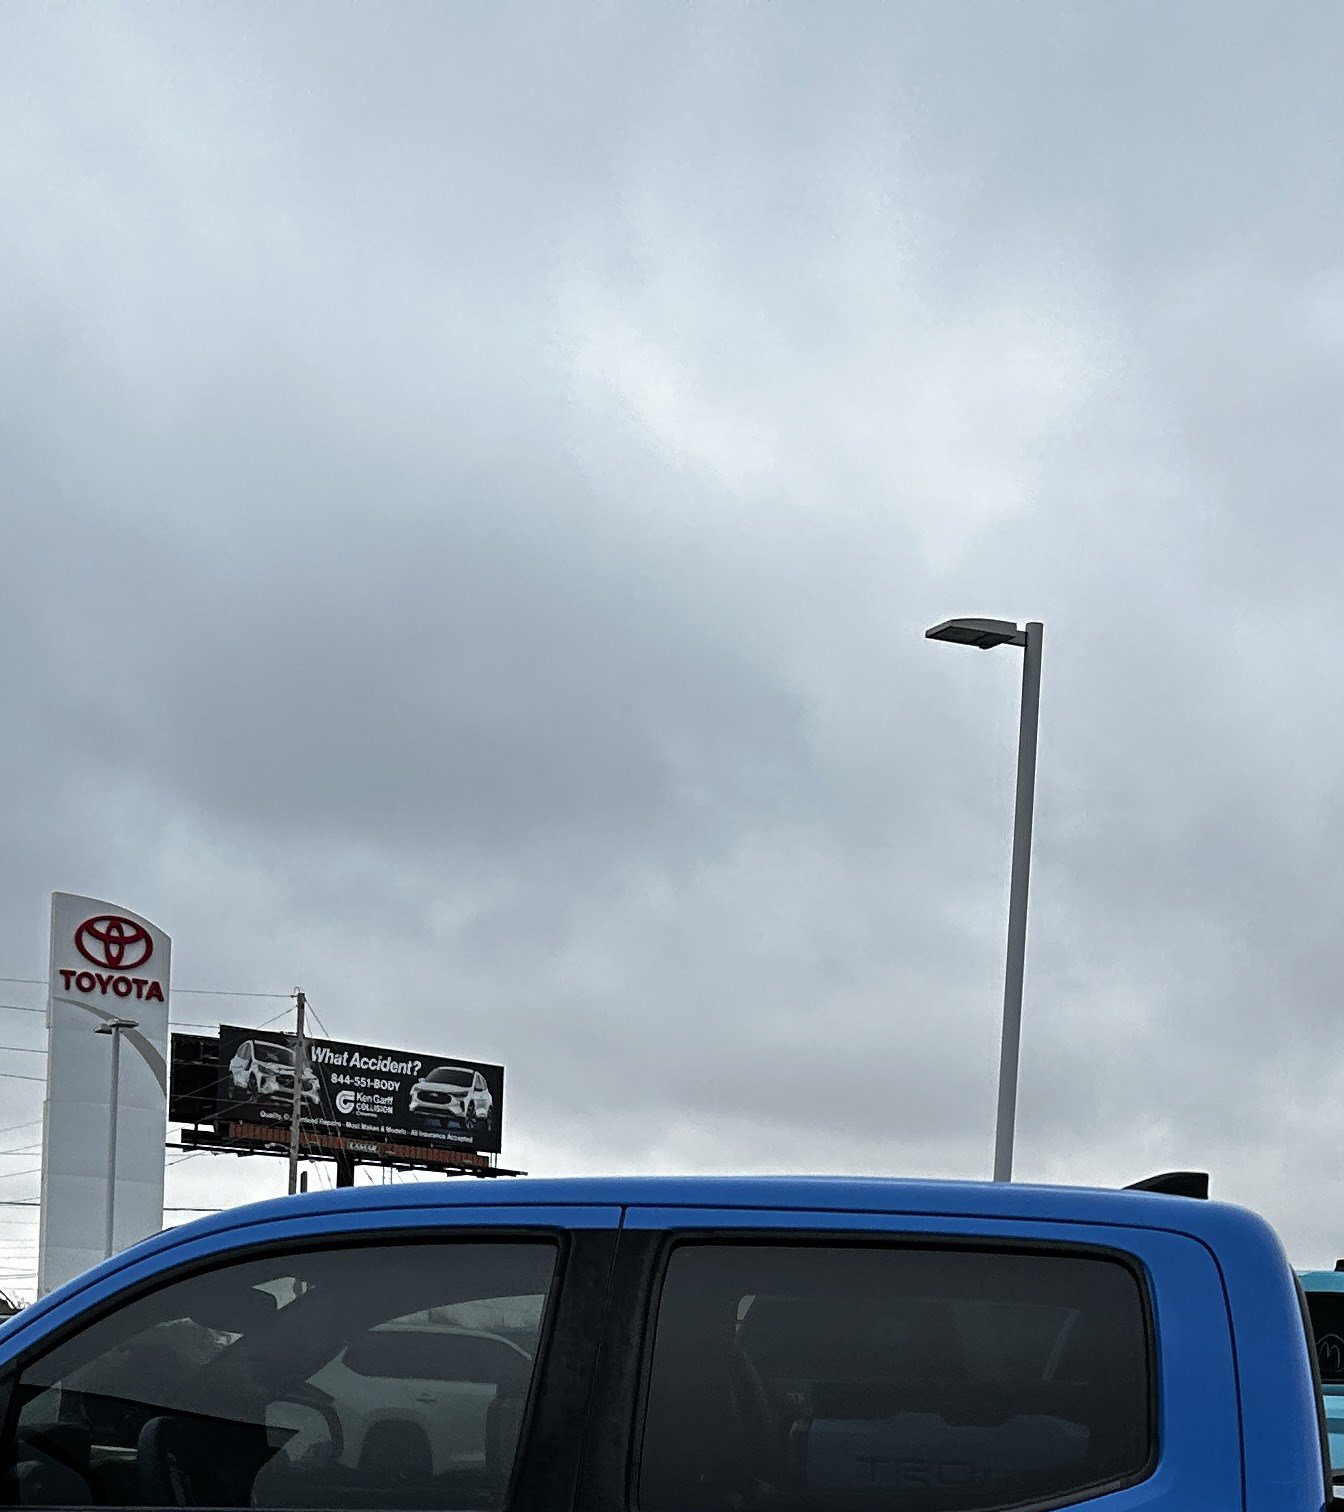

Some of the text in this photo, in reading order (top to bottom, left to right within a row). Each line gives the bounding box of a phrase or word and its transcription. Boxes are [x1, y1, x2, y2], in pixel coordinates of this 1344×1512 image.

[59, 969, 165, 1002] TOYOTA
[311, 1045, 422, 1076] What Accident?
[331, 1072, 401, 1091] 844-551-BODY
